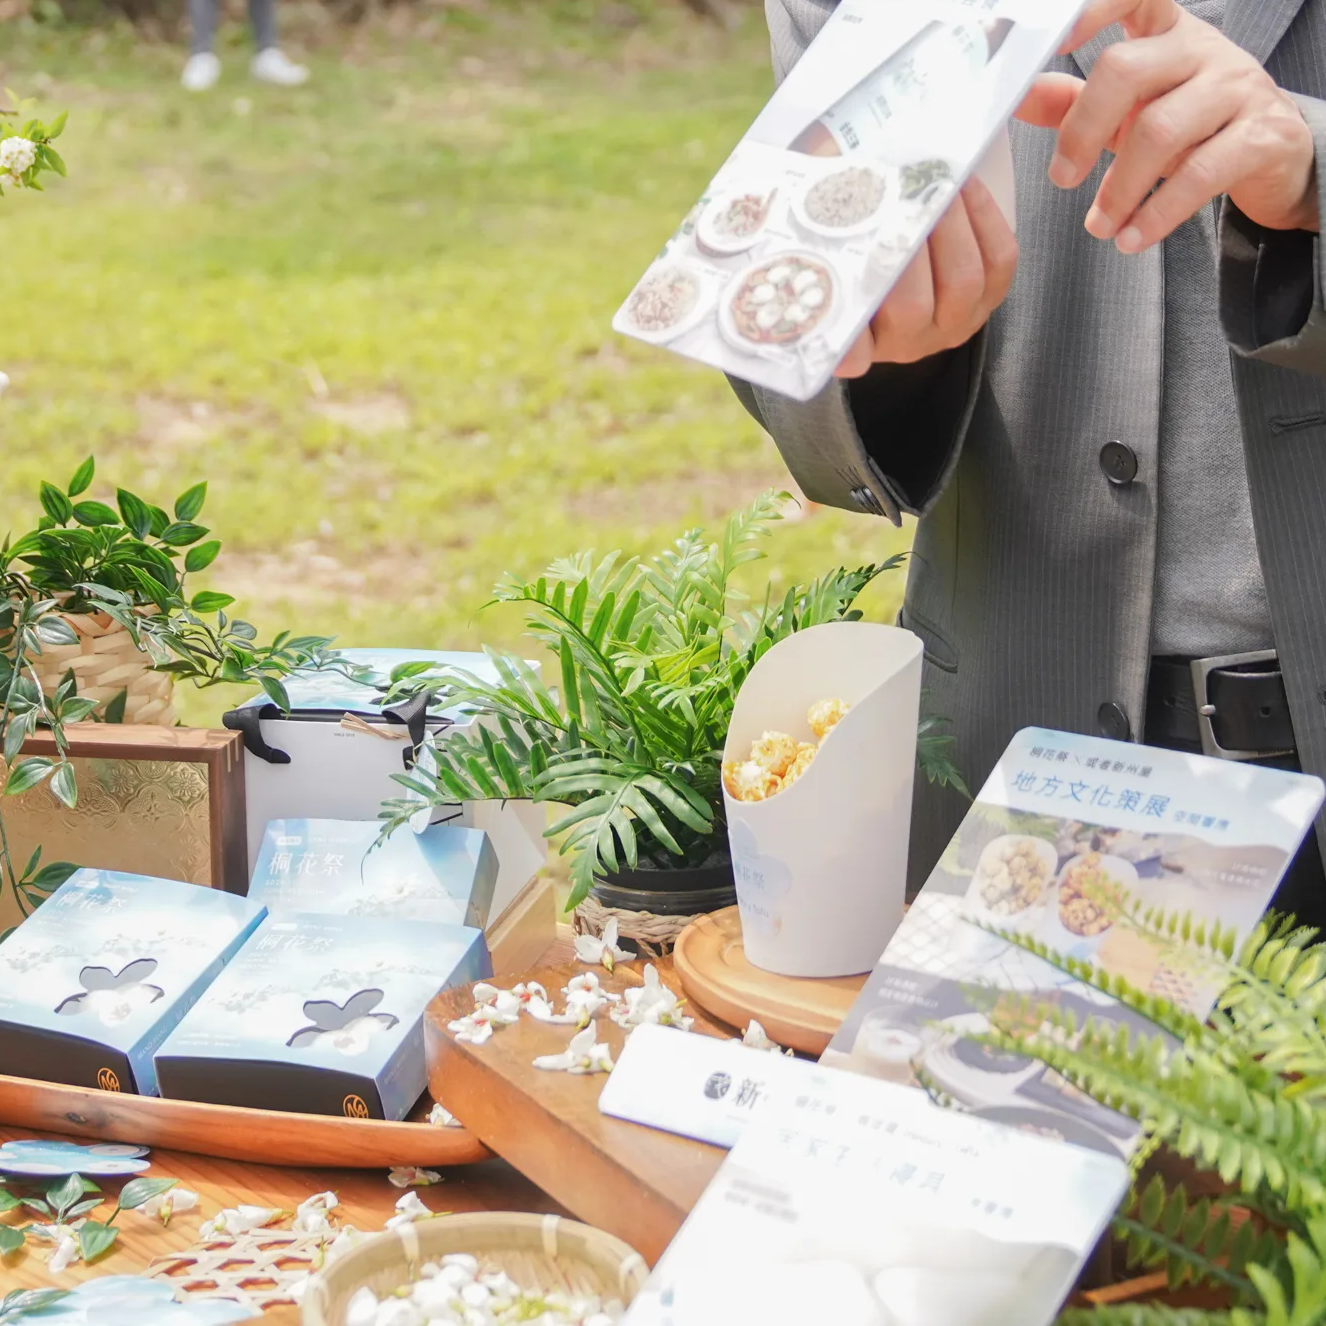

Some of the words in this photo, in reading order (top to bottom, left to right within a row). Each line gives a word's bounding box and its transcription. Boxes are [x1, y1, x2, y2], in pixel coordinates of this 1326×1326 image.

[1029, 745, 1070, 762] 桐花祭
[1011, 769, 1171, 818] 地方文化策展
[268, 851, 344, 876] 桐花祭
[733, 1076, 766, 1110] 新
